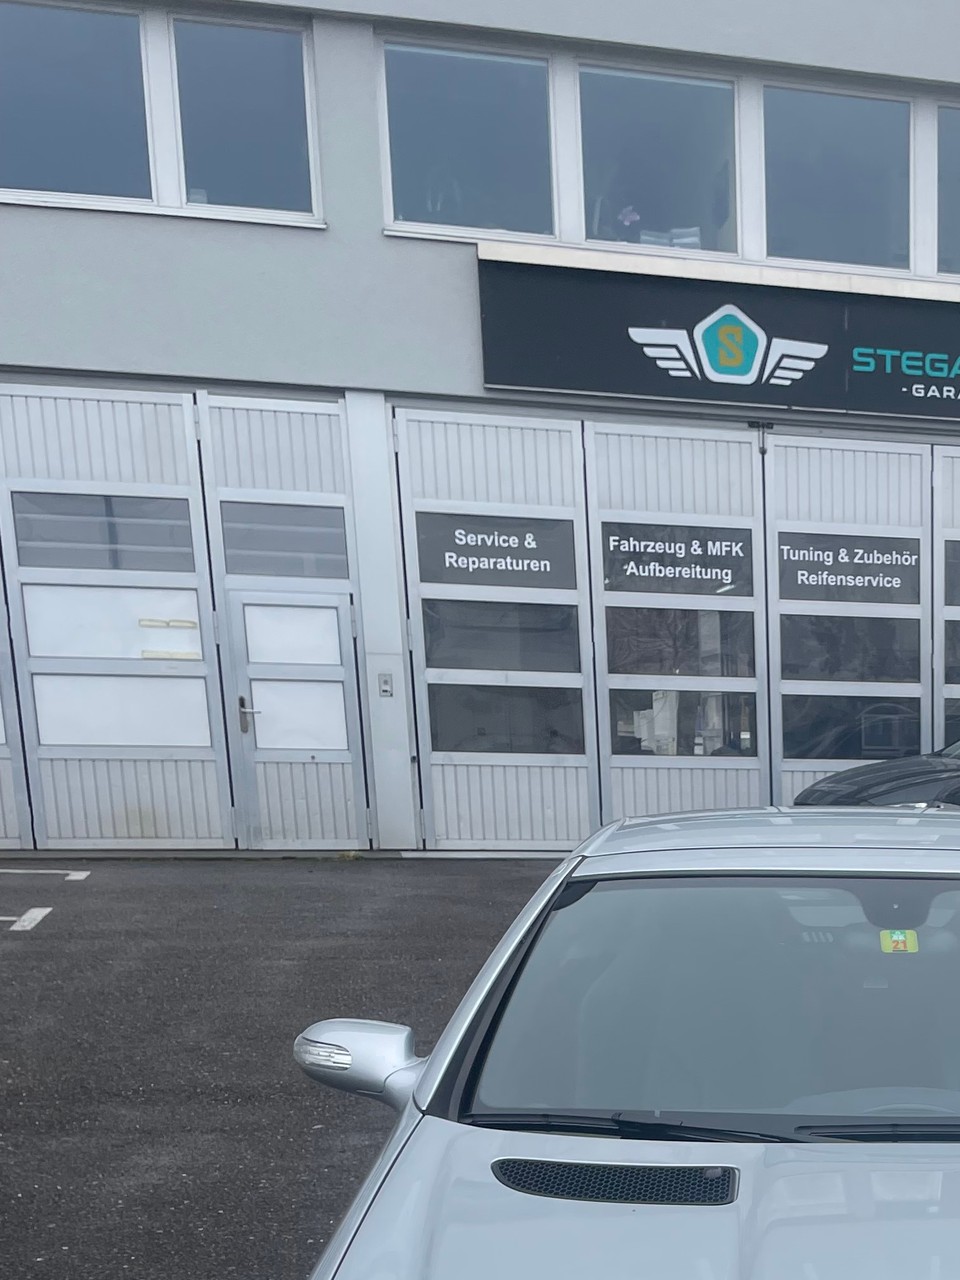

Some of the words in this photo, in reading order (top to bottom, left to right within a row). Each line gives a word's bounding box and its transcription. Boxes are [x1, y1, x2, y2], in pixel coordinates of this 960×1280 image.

[454, 529, 519, 548] Service
[524, 533, 537, 549] &
[609, 535, 686, 558] Fahrzeug
[690, 539, 703, 555] &
[707, 540, 745, 557] MFK
[444, 551, 551, 573] Reparaturen
[779, 545, 834, 566] Tuning
[837, 548, 850, 563] &
[853, 548, 918, 567] Zubehör
[626, 560, 732, 584] Aufbereitung
[797, 570, 902, 589] Reifenservice
